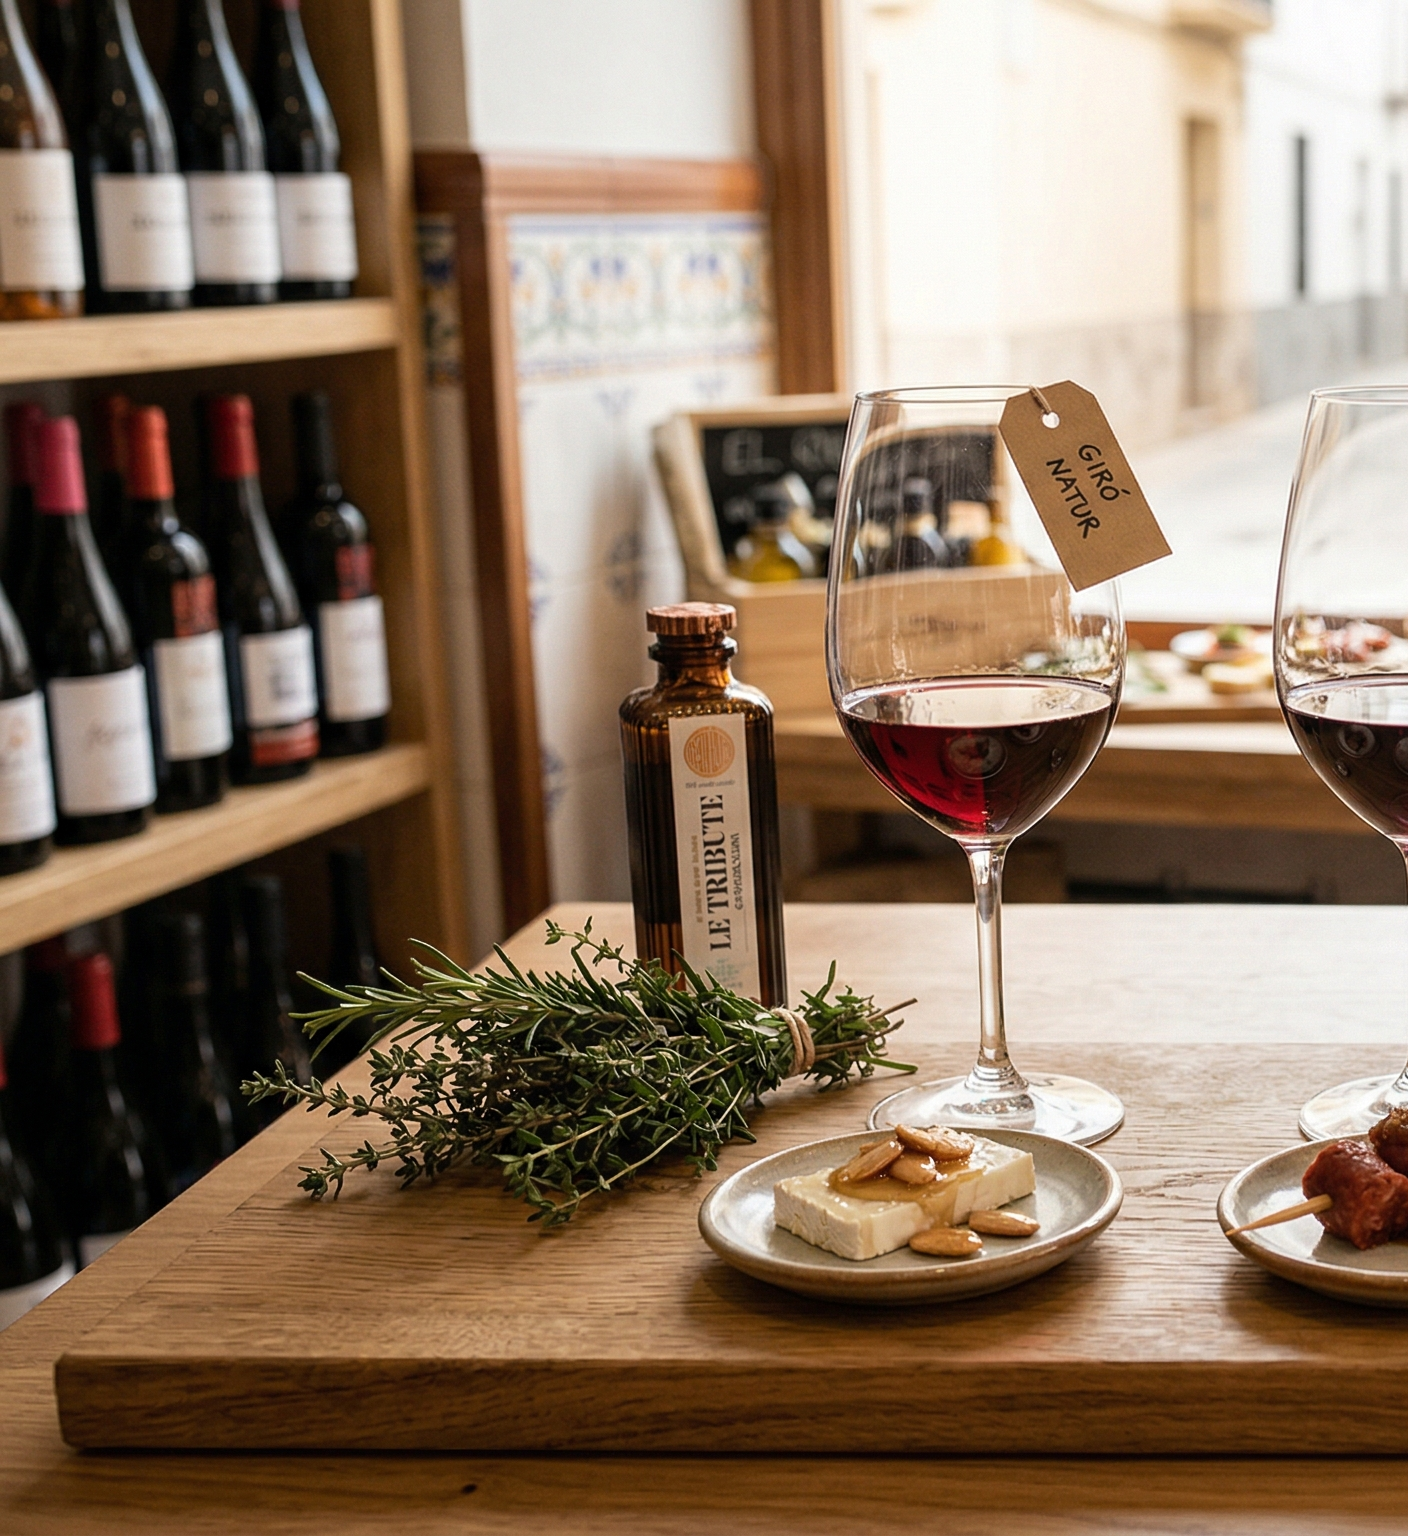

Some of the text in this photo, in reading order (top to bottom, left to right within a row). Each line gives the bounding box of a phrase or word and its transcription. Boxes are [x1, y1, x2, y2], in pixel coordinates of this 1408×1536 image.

[1046, 458, 1100, 539] NATUR
[1078, 444, 1131, 501] GIRÓ
[700, 794, 730, 922] TRIBUTE
[709, 918, 732, 951] LE
